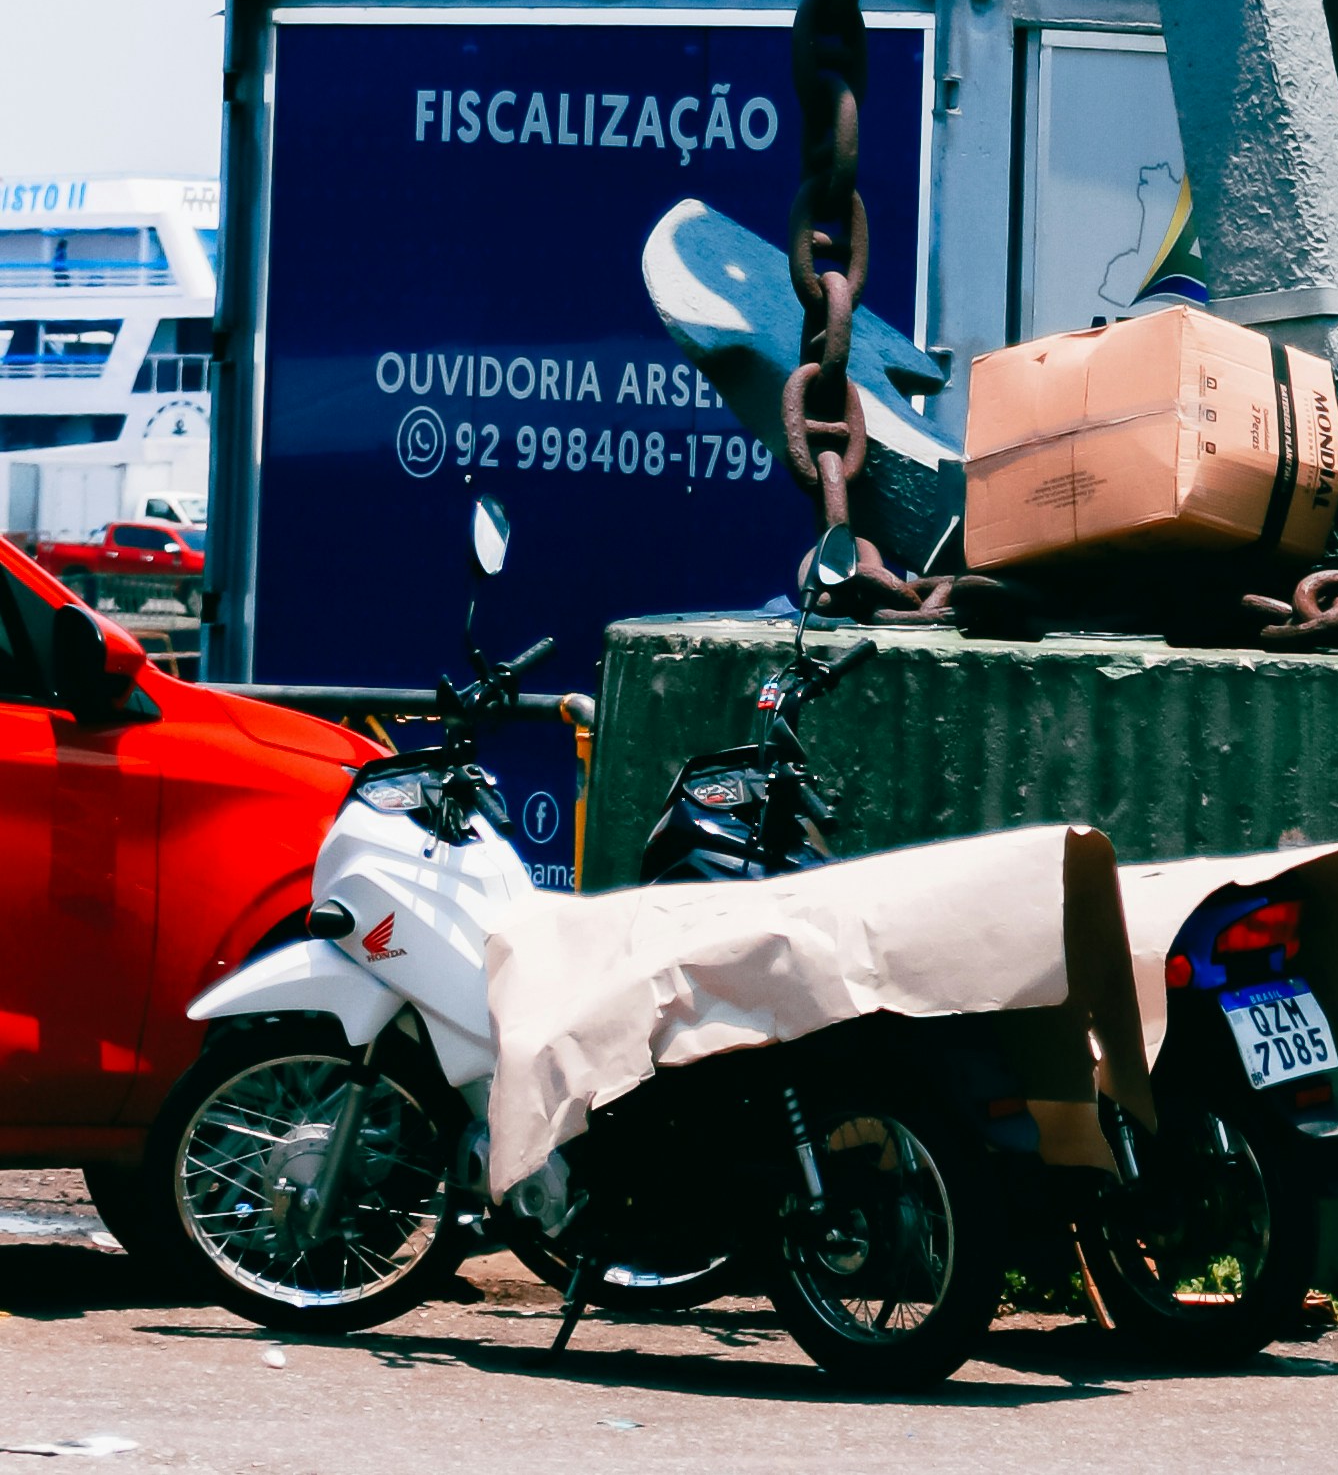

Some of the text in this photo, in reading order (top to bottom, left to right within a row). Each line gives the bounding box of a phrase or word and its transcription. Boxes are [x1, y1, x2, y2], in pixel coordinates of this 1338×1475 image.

[415, 83, 778, 166] FISCALIZAÇÃO
[376, 351, 602, 400] OUVIDORIA
[455, 422, 773, 481] 92 998408-1799
[1312, 389, 1336, 510] MONDIAL
[366, 948, 408, 963] HONDA
[1248, 997, 1309, 1037] QZM
[1249, 989, 1283, 1004] BRASIL
[1253, 1027, 1328, 1077] 7D85
